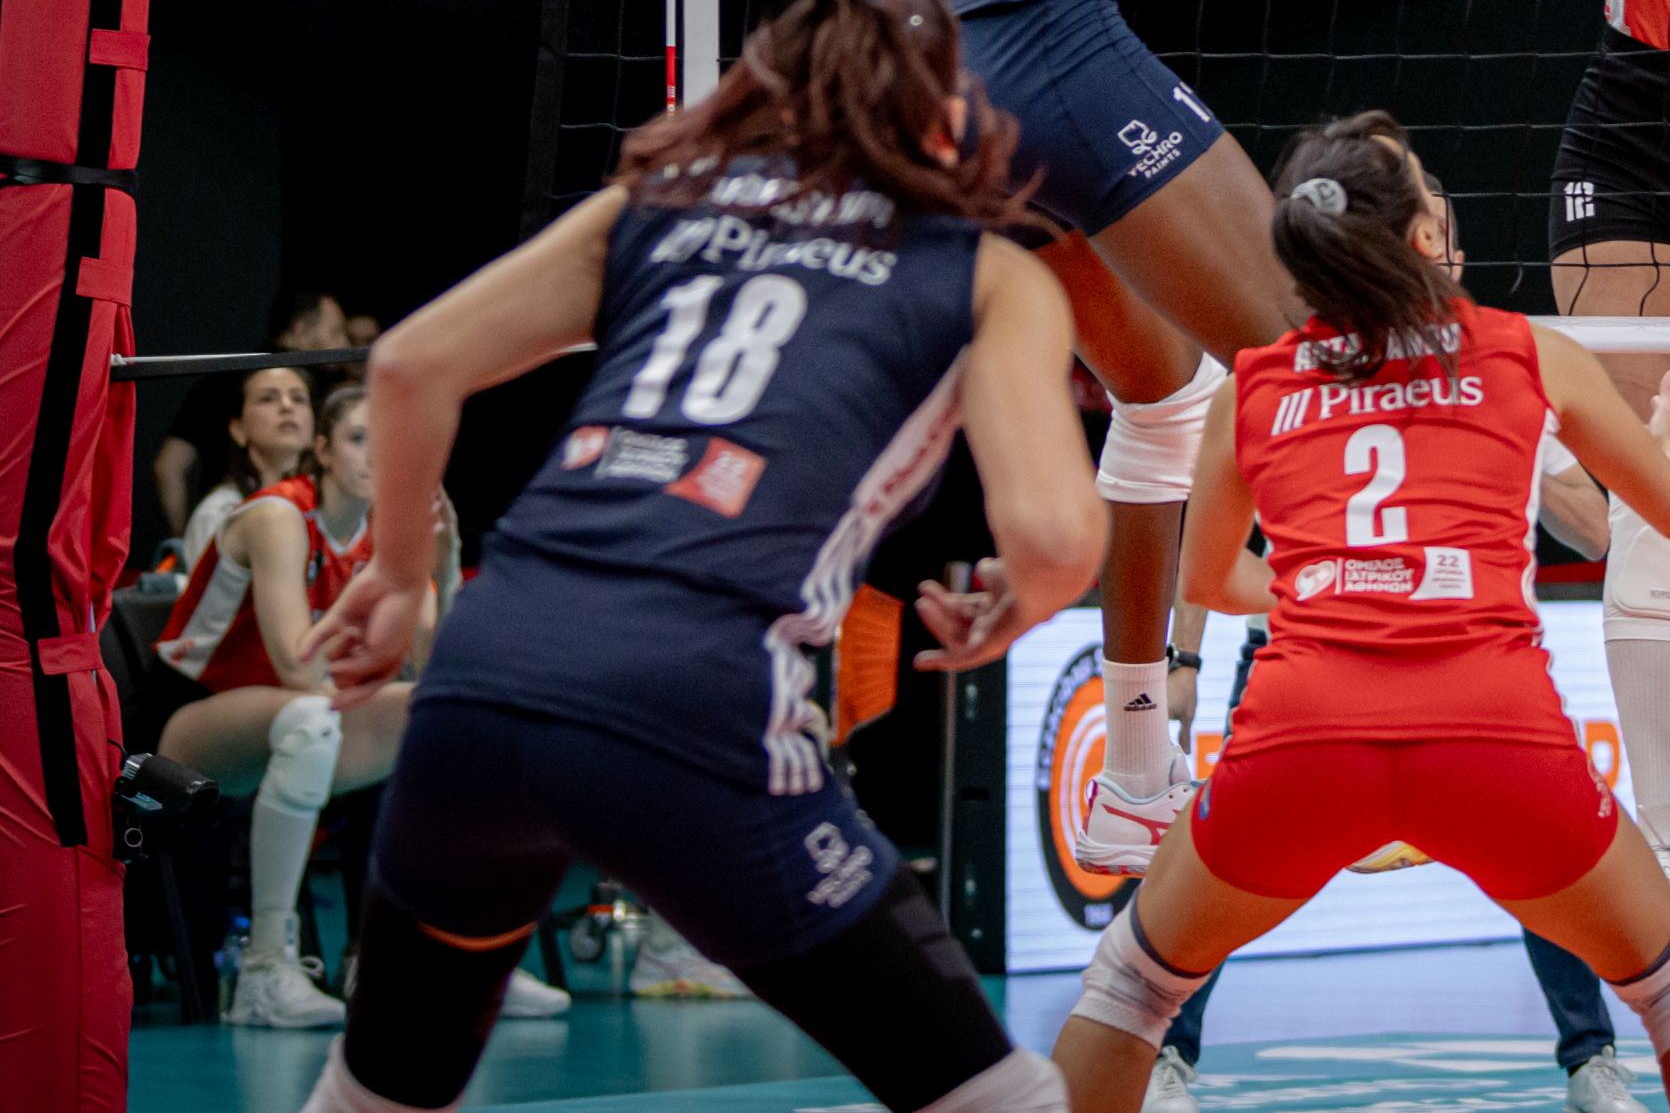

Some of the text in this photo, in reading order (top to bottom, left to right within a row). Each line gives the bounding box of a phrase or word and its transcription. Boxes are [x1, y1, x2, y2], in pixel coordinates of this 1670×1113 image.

[1563, 181, 1596, 223] 12
[620, 274, 809, 426] 18
[1318, 375, 1485, 421] Piraeus
[1343, 423, 1410, 548] 2
[1437, 554, 1459, 568] 22
